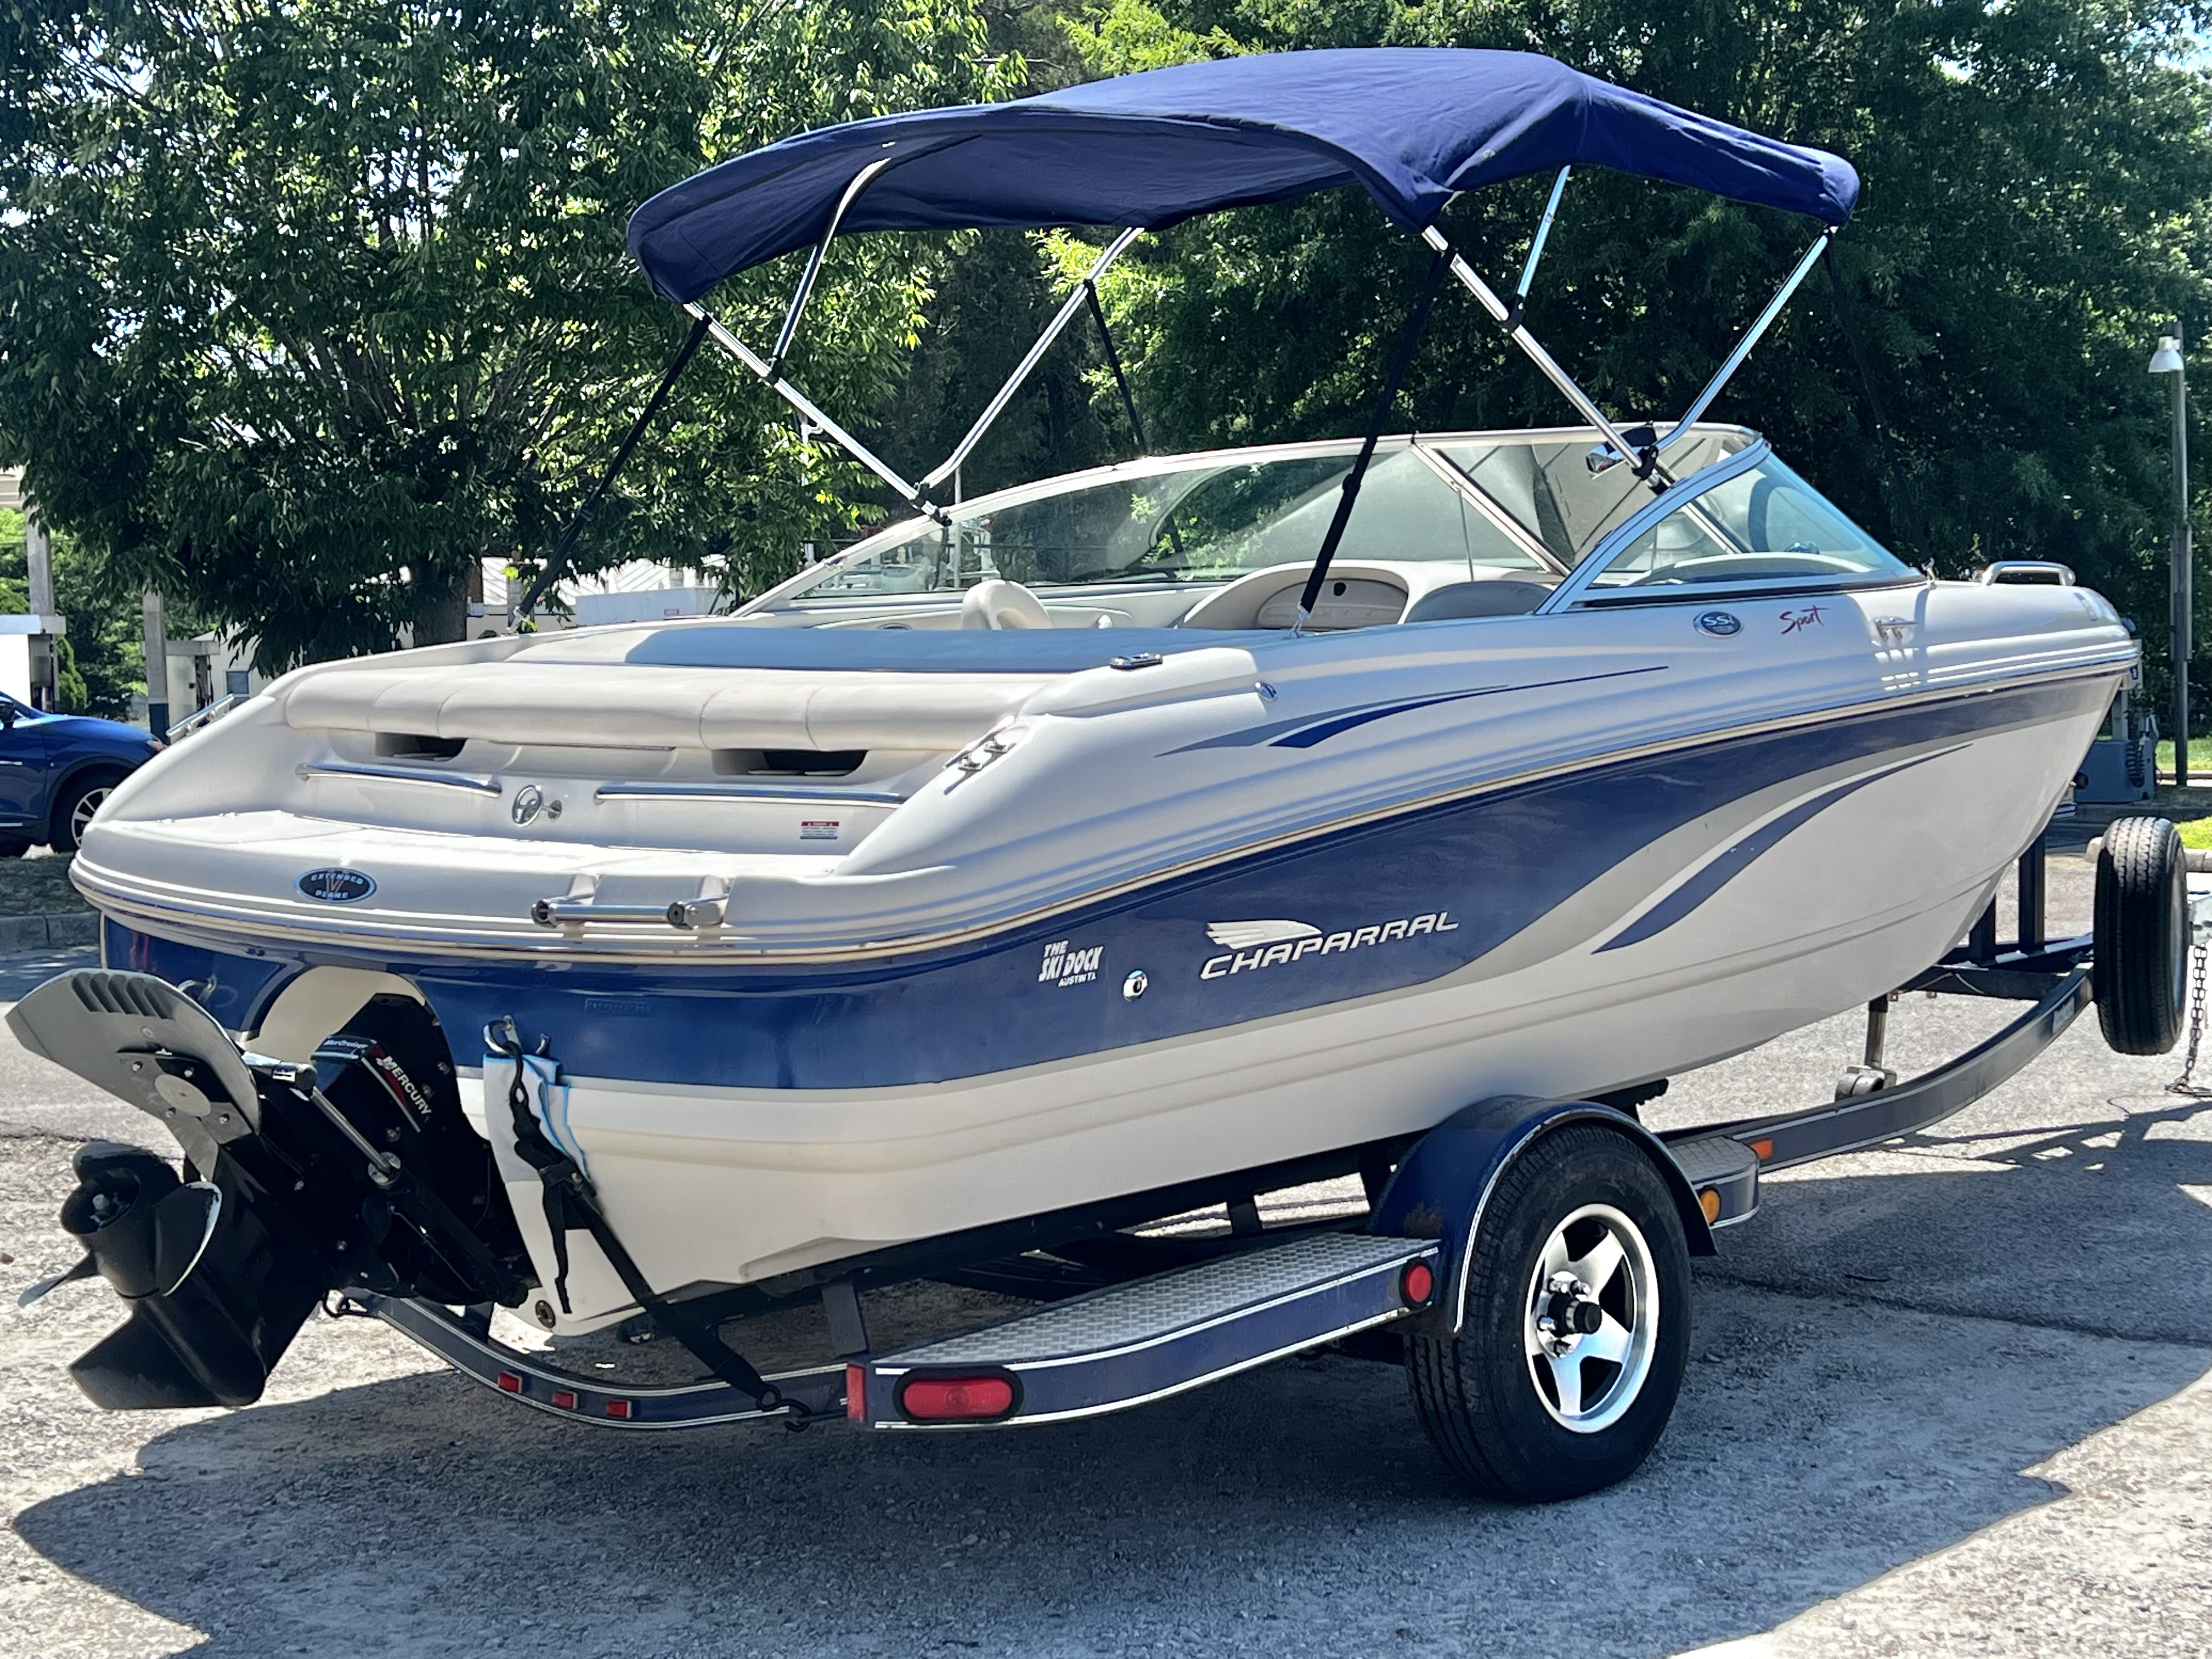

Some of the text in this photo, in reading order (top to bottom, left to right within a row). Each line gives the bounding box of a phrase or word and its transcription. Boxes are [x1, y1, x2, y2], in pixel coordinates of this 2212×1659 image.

[1779, 605, 1831, 635] Sport
[310, 872, 364, 885] EXTENDED
[315, 889, 349, 899] PLANE
[1043, 940, 1069, 958] THE
[1200, 911, 1459, 980] CHAPARRAL
[1038, 945, 1104, 982] SKI DOCK
[383, 1055, 432, 1115] MERCURY
